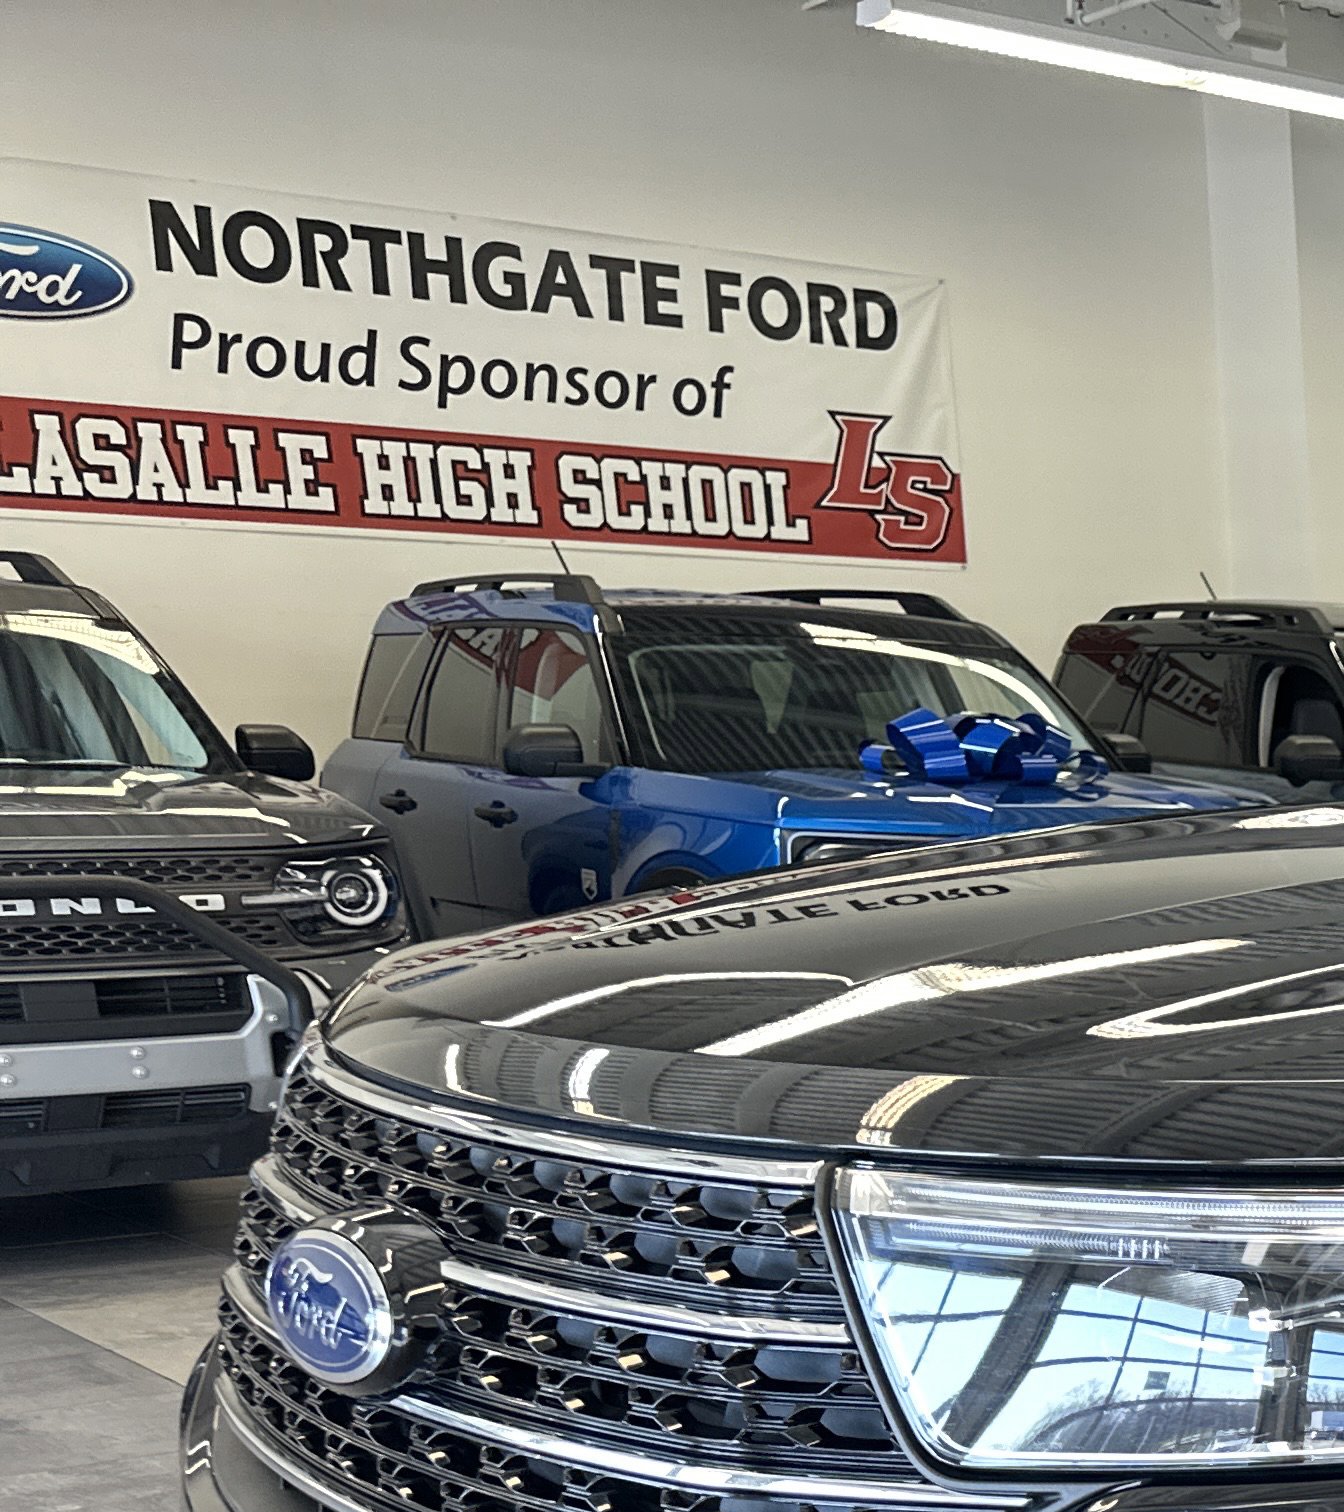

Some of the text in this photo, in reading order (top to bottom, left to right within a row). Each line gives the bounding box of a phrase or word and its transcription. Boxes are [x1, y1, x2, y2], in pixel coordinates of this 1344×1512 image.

[0, 242, 83, 306] rd
[148, 199, 899, 352] NORTHGATE FORD
[170, 312, 735, 419] Proud Sponsor of
[352, 436, 542, 526] HIGH
[556, 452, 812, 544] SCHOOL
[814, 410, 956, 550] LS
[277, 1257, 350, 1350] Ford
